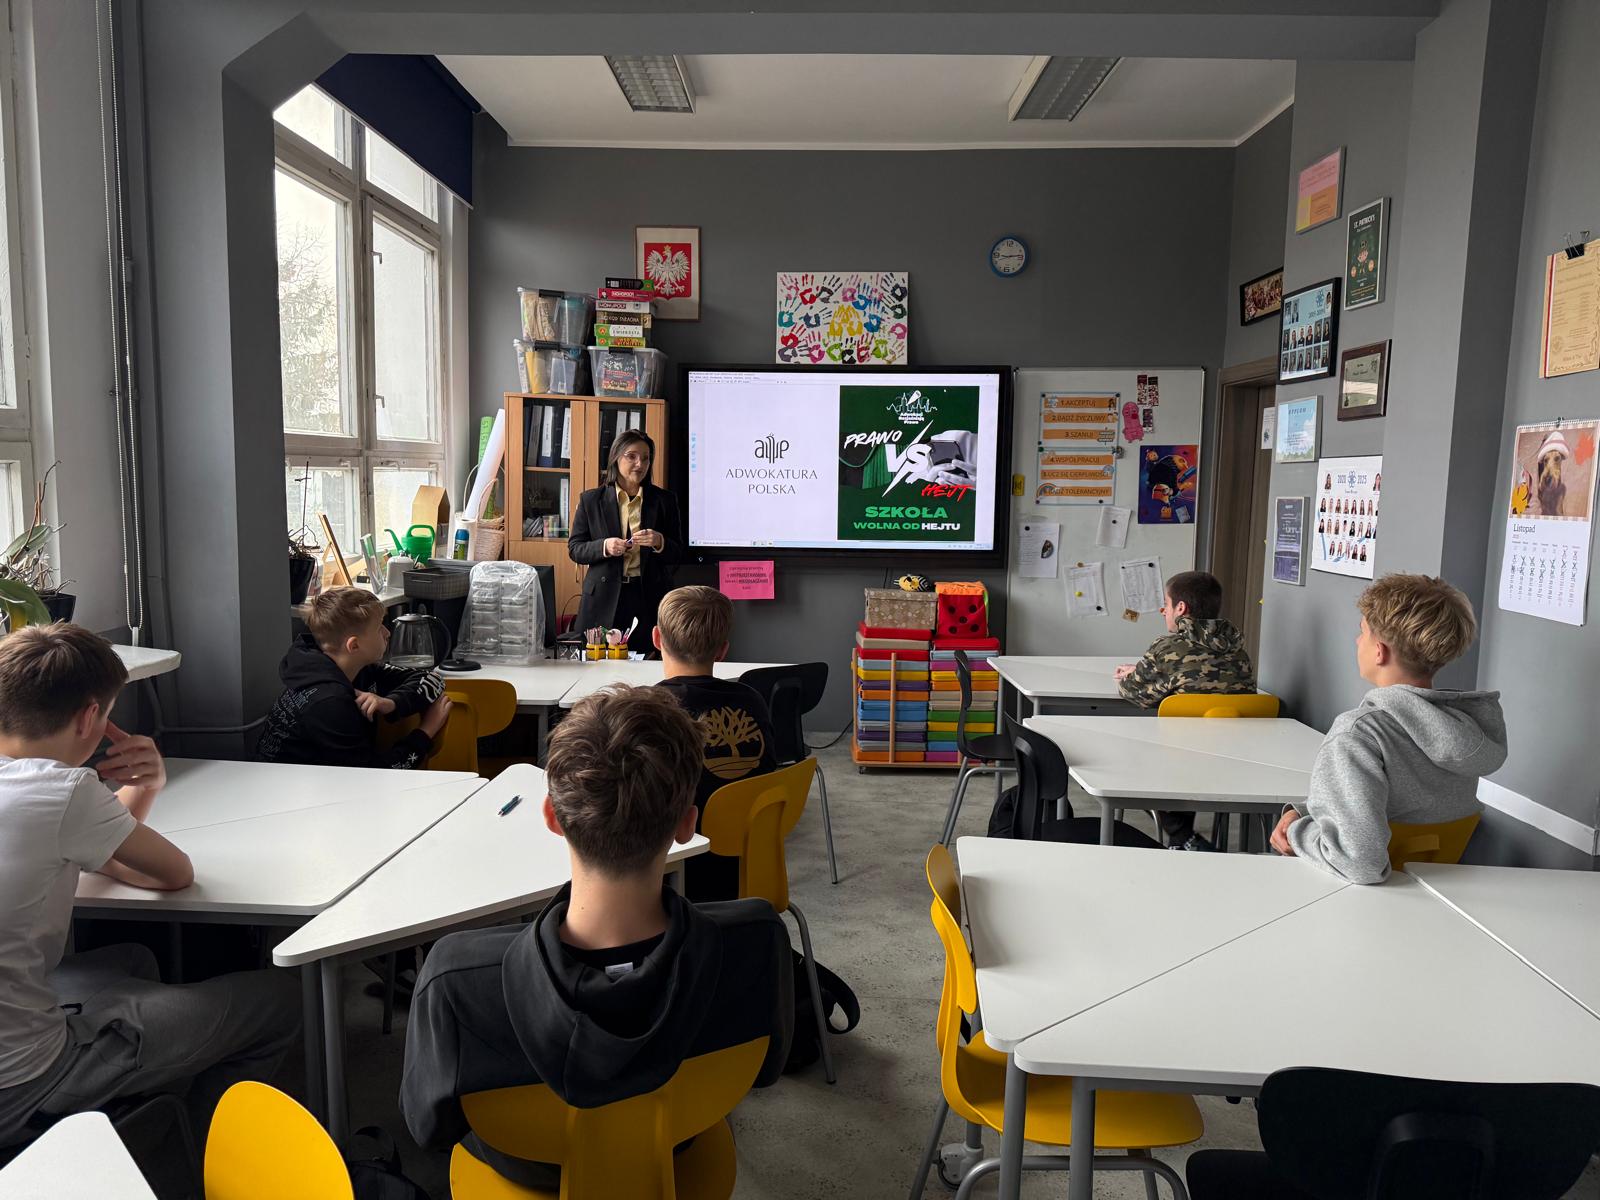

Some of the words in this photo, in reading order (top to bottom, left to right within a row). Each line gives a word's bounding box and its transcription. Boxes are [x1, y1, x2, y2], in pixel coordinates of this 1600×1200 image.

[843, 430, 903, 449] PRAWO
[884, 443, 933, 473] VS
[725, 468, 818, 480] ADWOKATURA
[748, 484, 796, 495] POLSKA
[921, 484, 974, 502] HEJT
[865, 506, 949, 519] SZKOŁA
[853, 522, 901, 530] WOLNA
[902, 522, 920, 530] OD
[921, 523, 961, 531] HEJTU
[1513, 524, 1536, 534] Listopad
